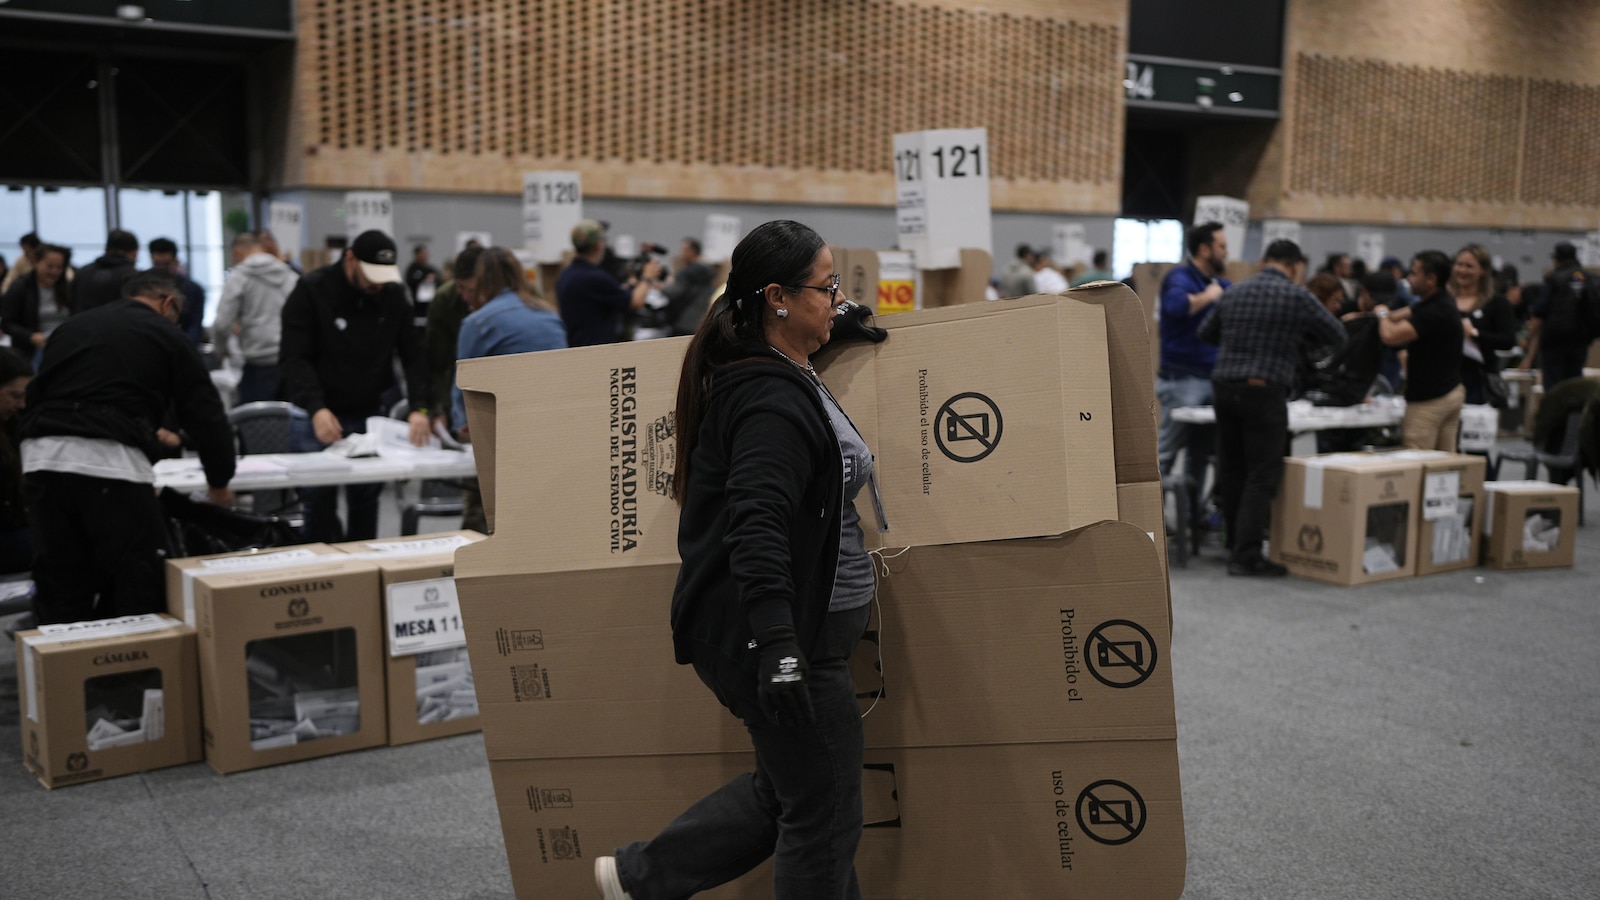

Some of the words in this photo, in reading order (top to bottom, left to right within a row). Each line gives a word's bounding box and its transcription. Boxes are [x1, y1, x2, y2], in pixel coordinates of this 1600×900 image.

[931, 144, 981, 179] 121
[543, 181, 579, 205] 120
[877, 284, 915, 305] NO
[610, 368, 619, 431] NACIONAL
[918, 369, 929, 416] Prohibido
[921, 418, 930, 427] el
[1080, 411, 1091, 421] 2
[610, 436, 619, 461] DEL
[921, 429, 929, 446] uso
[621, 366, 643, 553] REGISTRADURÍA
[922, 448, 931, 460] de
[610, 465, 620, 515] ESTADO
[922, 462, 932, 496] celular
[610, 519, 620, 553] CIVIL
[260, 580, 334, 598] CONSULTAS
[395, 618, 437, 638] MESA
[441, 615, 464, 633] 11
[92, 650, 150, 666] CÁMARA
[1060, 608, 1080, 684] Prohibido
[1067, 688, 1083, 702] el
[1051, 770, 1064, 796] uso
[1055, 800, 1070, 817] de
[1057, 821, 1075, 871] celular
